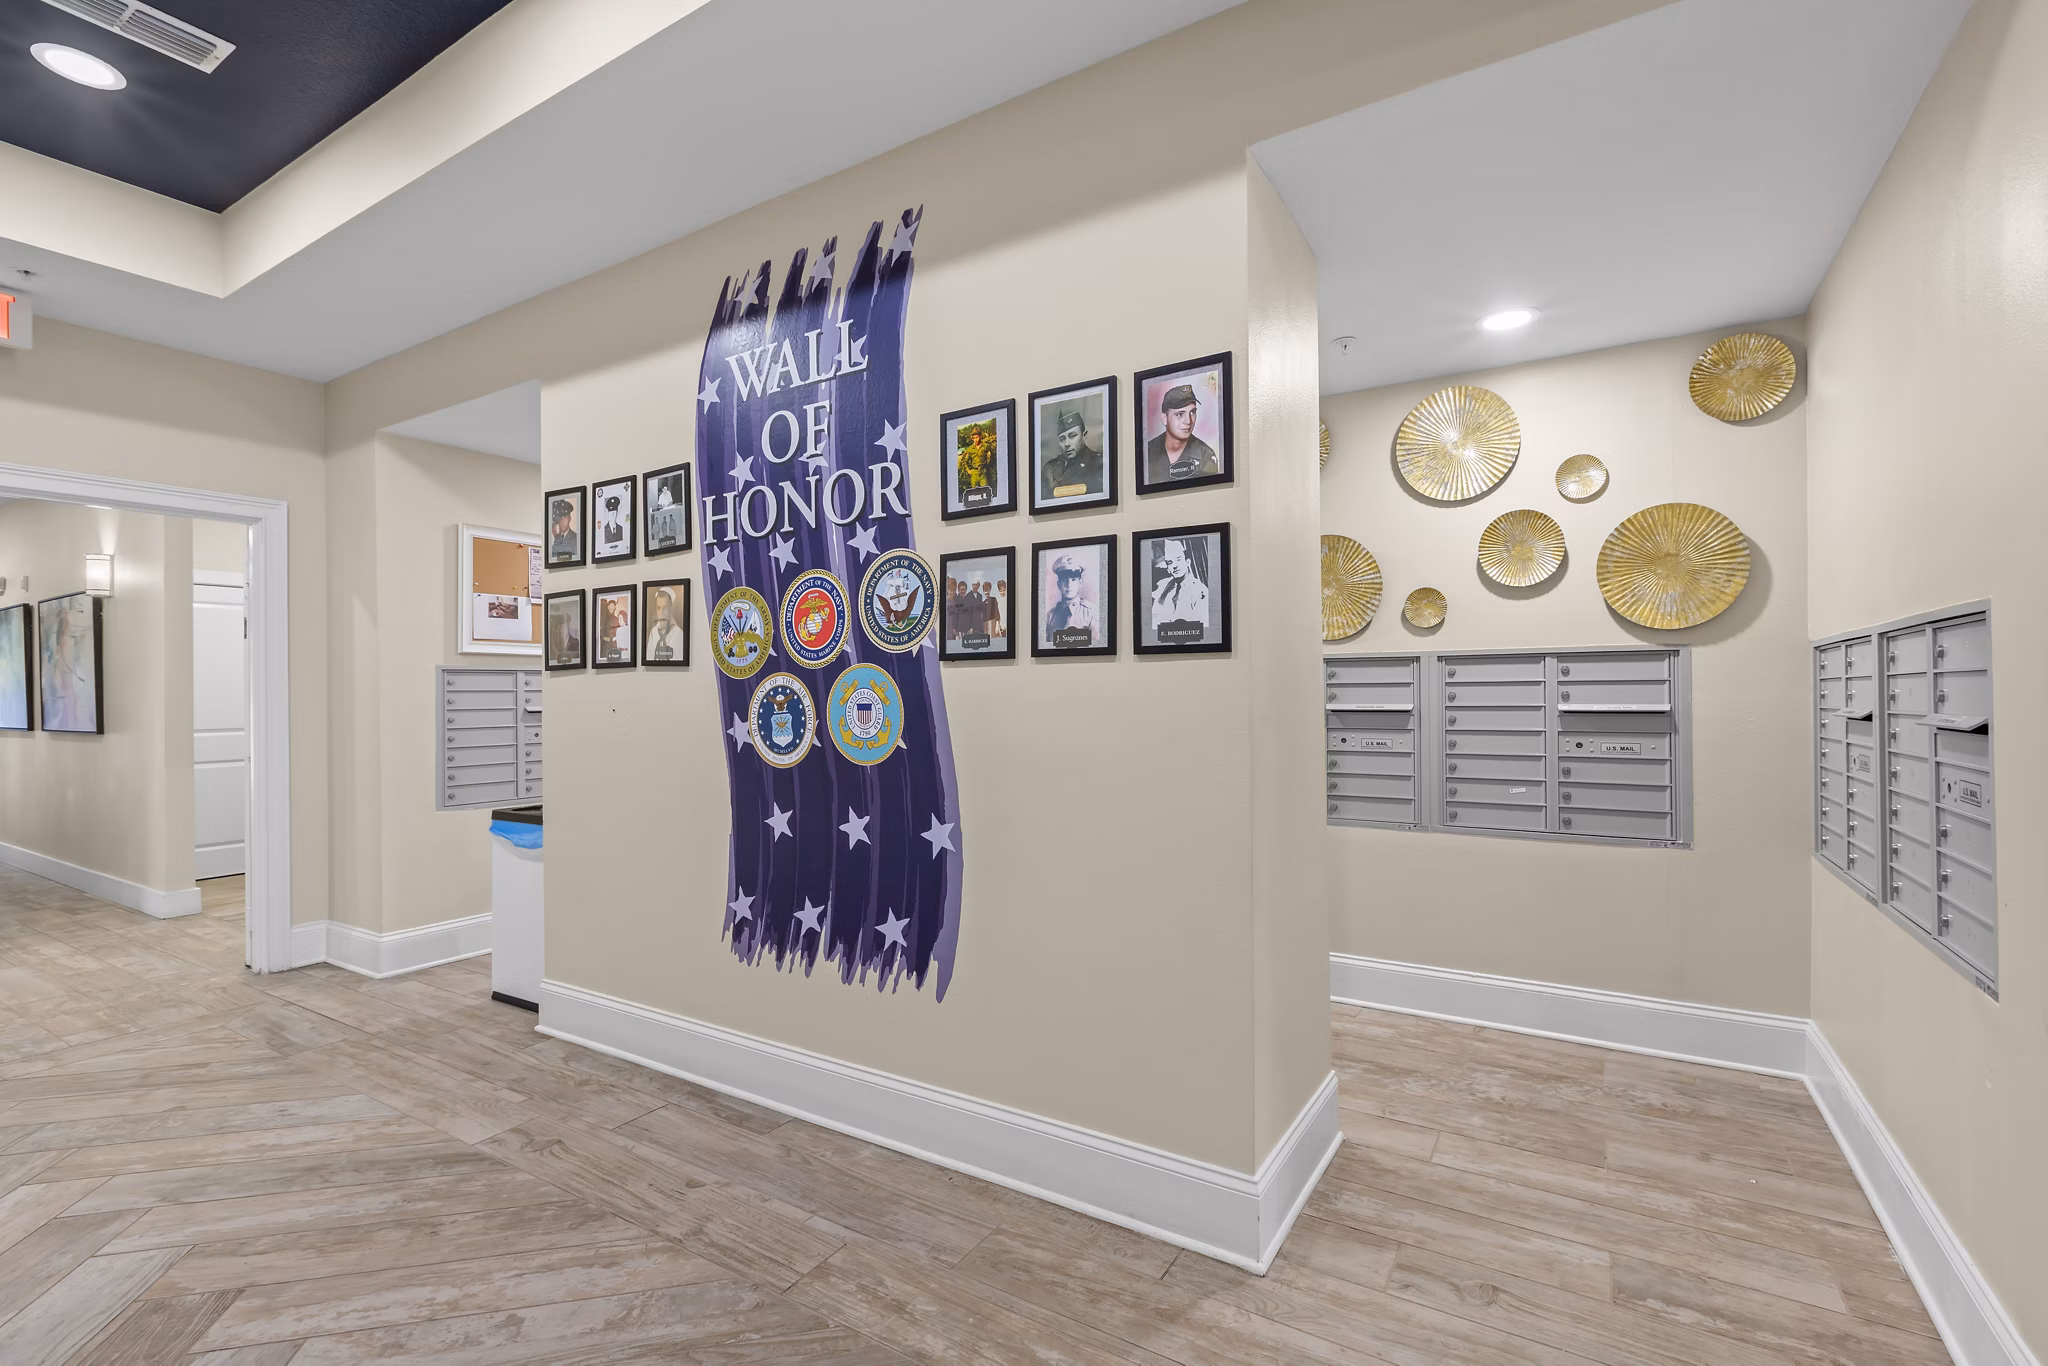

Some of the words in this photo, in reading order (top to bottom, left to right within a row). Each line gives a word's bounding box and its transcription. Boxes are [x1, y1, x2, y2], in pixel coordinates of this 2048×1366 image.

[725, 318, 868, 402] WALL
[761, 399, 832, 464] OF
[702, 462, 911, 545] HONOR
[867, 559, 899, 597] DEPARTMENT
[900, 559, 910, 567] OF
[911, 562, 923, 575] THE
[921, 574, 933, 595] NAVY
[713, 592, 737, 632] DEPARTMENT
[749, 594, 760, 605] THE
[759, 606, 770, 626] ARMY
[786, 579, 814, 622] DEPARTMENT
[822, 581, 832, 591] THE
[831, 589, 843, 611] NAVY
[787, 628, 801, 651] UNITED
[800, 649, 817, 659] STATES
[818, 641, 837, 658] MARINE
[834, 619, 843, 640] CORPS
[865, 605, 879, 633] UNITED
[878, 631, 899, 643] STATES
[900, 635, 909, 643] OF
[910, 607, 931, 639] AMERICA
[1055, 634, 1061, 643] J.
[1062, 634, 1088, 643] Sugranes
[713, 639, 726, 665] UNITED
[726, 663, 747, 675] STATES
[748, 665, 755, 673] OF
[755, 632, 770, 666] AMERICA
[751, 686, 767, 738] DEPARTMENT
[769, 678, 778, 687] OF
[782, 677, 795, 687] THE
[796, 687, 808, 700] AIR
[805, 704, 814, 734] FORCE
[847, 705, 856, 729] UNITED
[851, 690, 866, 706] STATES
[866, 690, 880, 708] COAST
[873, 707, 882, 731] GUARD
[1969, 789, 1979, 799] MAIL
